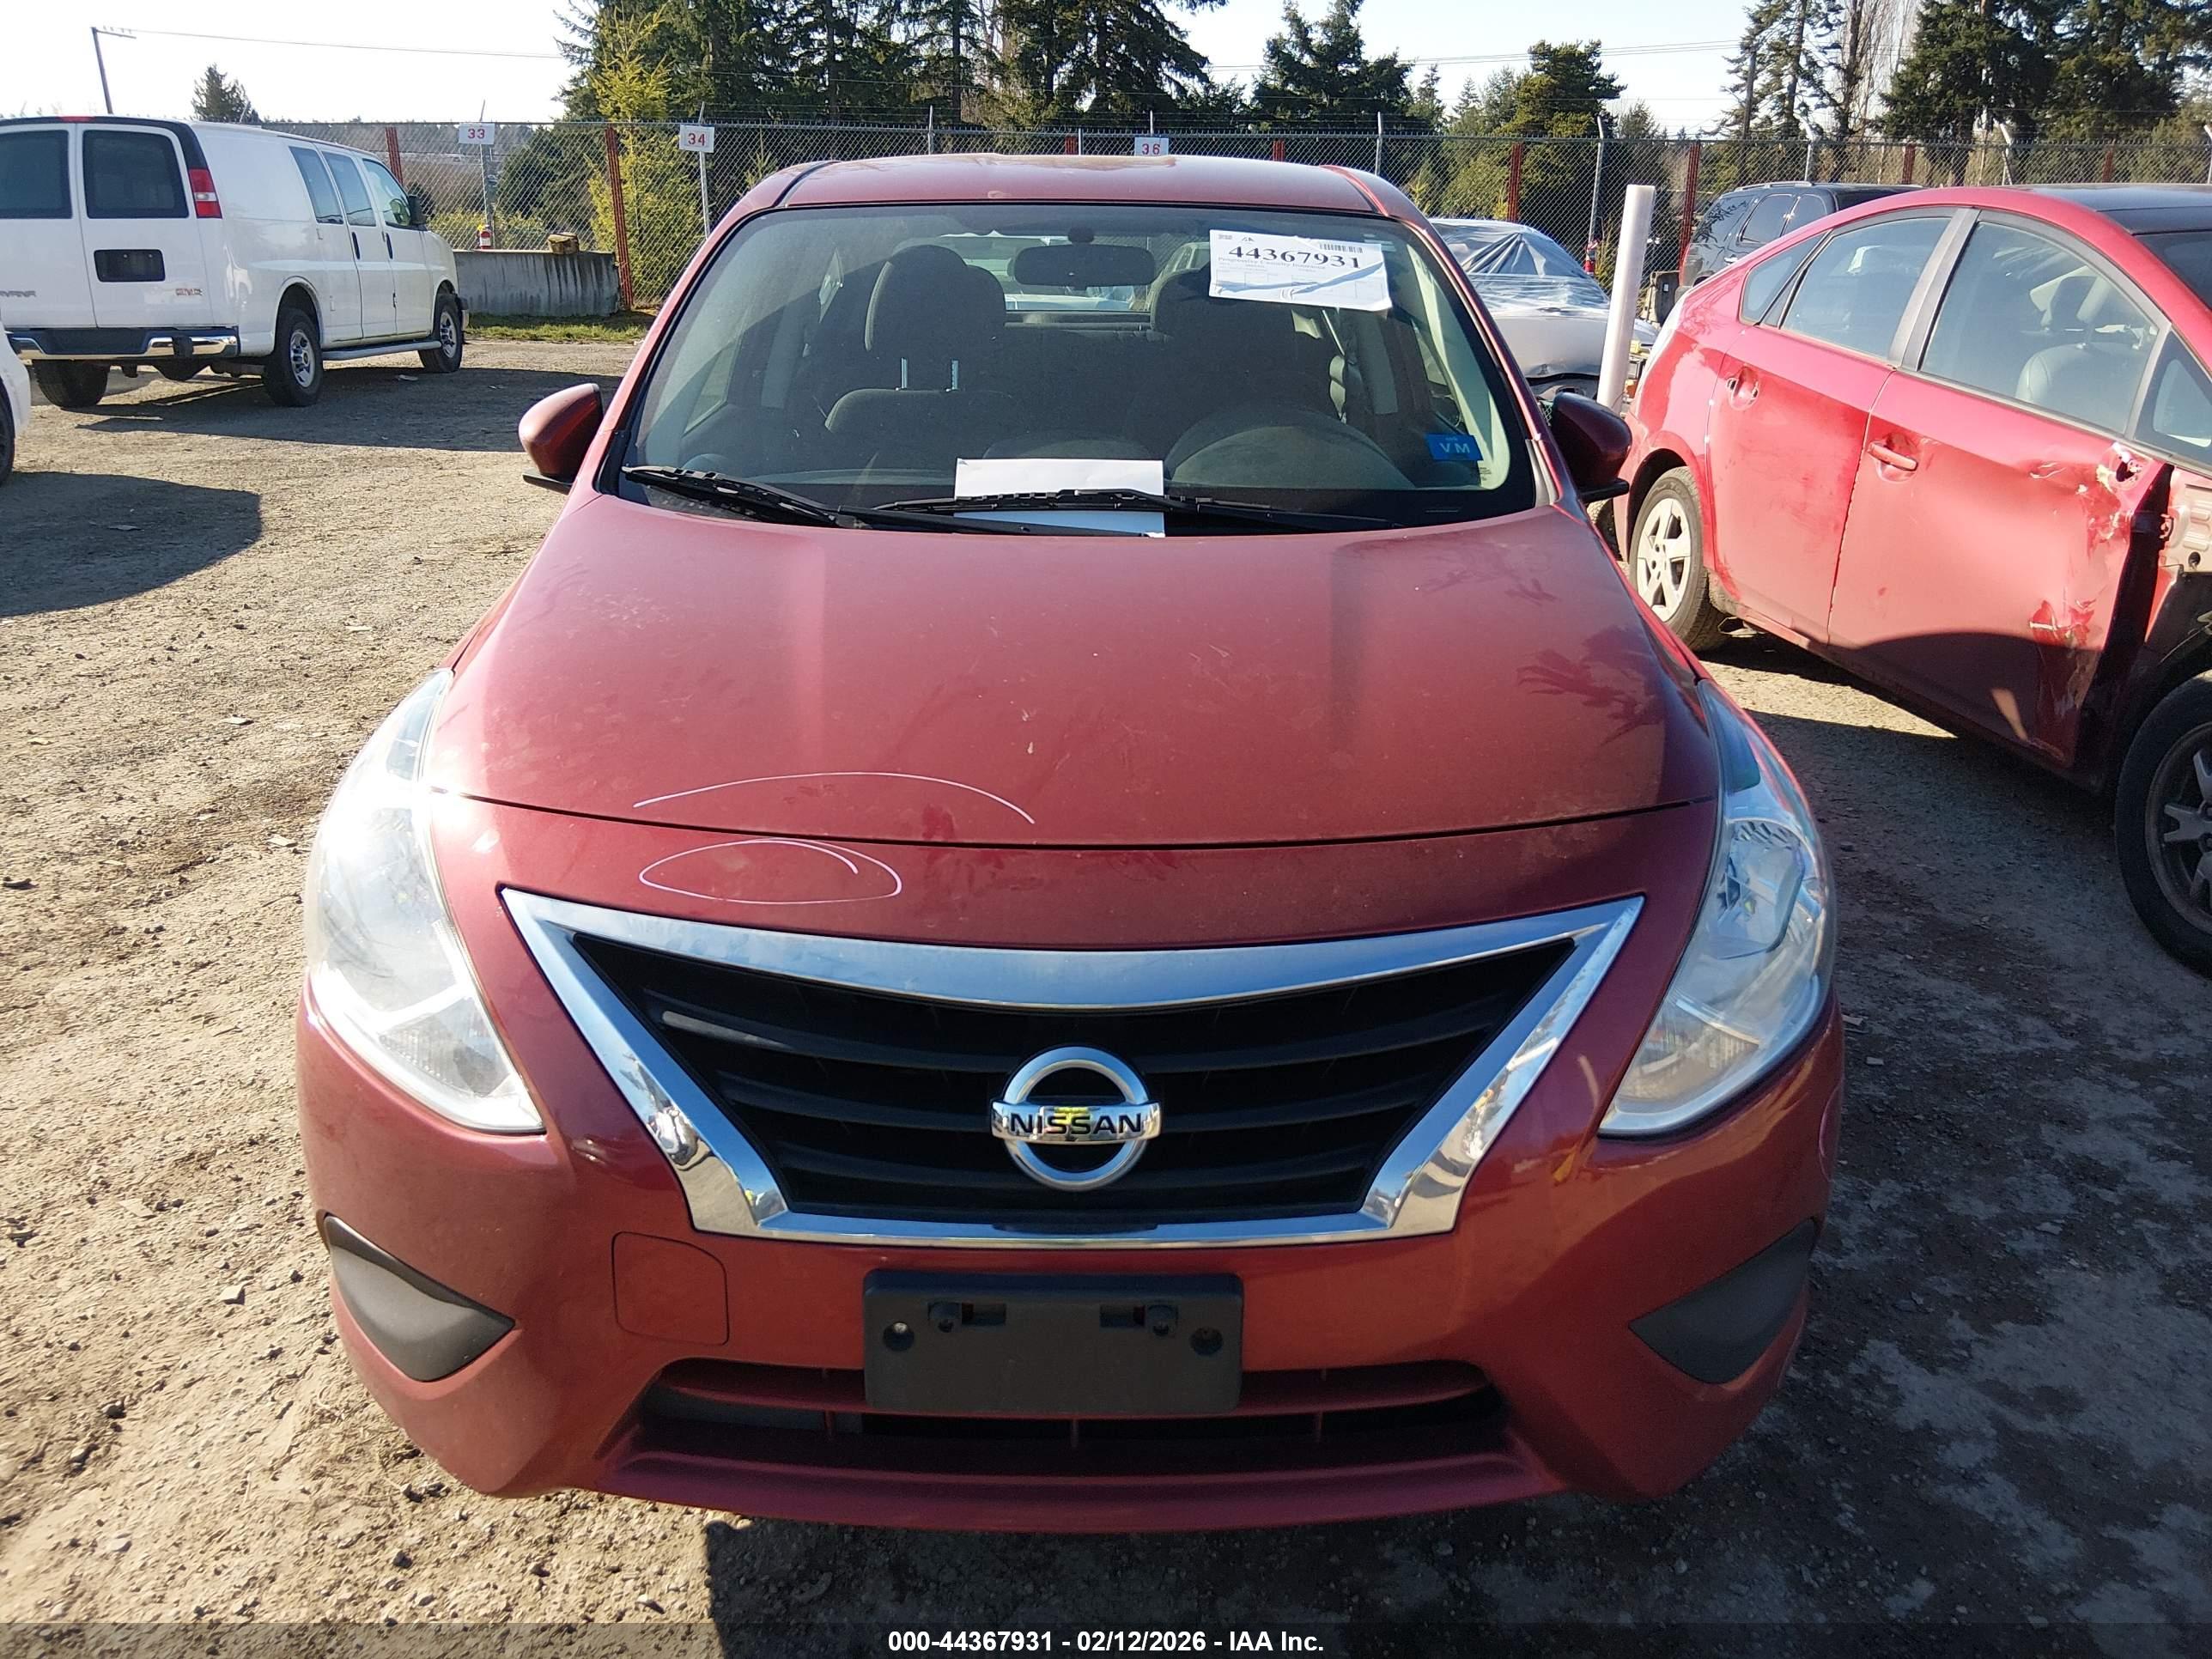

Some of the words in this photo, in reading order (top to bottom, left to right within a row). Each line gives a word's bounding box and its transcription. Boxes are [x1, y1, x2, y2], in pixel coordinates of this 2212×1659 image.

[468, 128, 485, 139] 33
[688, 132, 705, 146] 34
[1141, 143, 1161, 155] 36
[1229, 246, 1360, 269] 44367931
[1010, 1112, 1142, 1135] NISSAN
